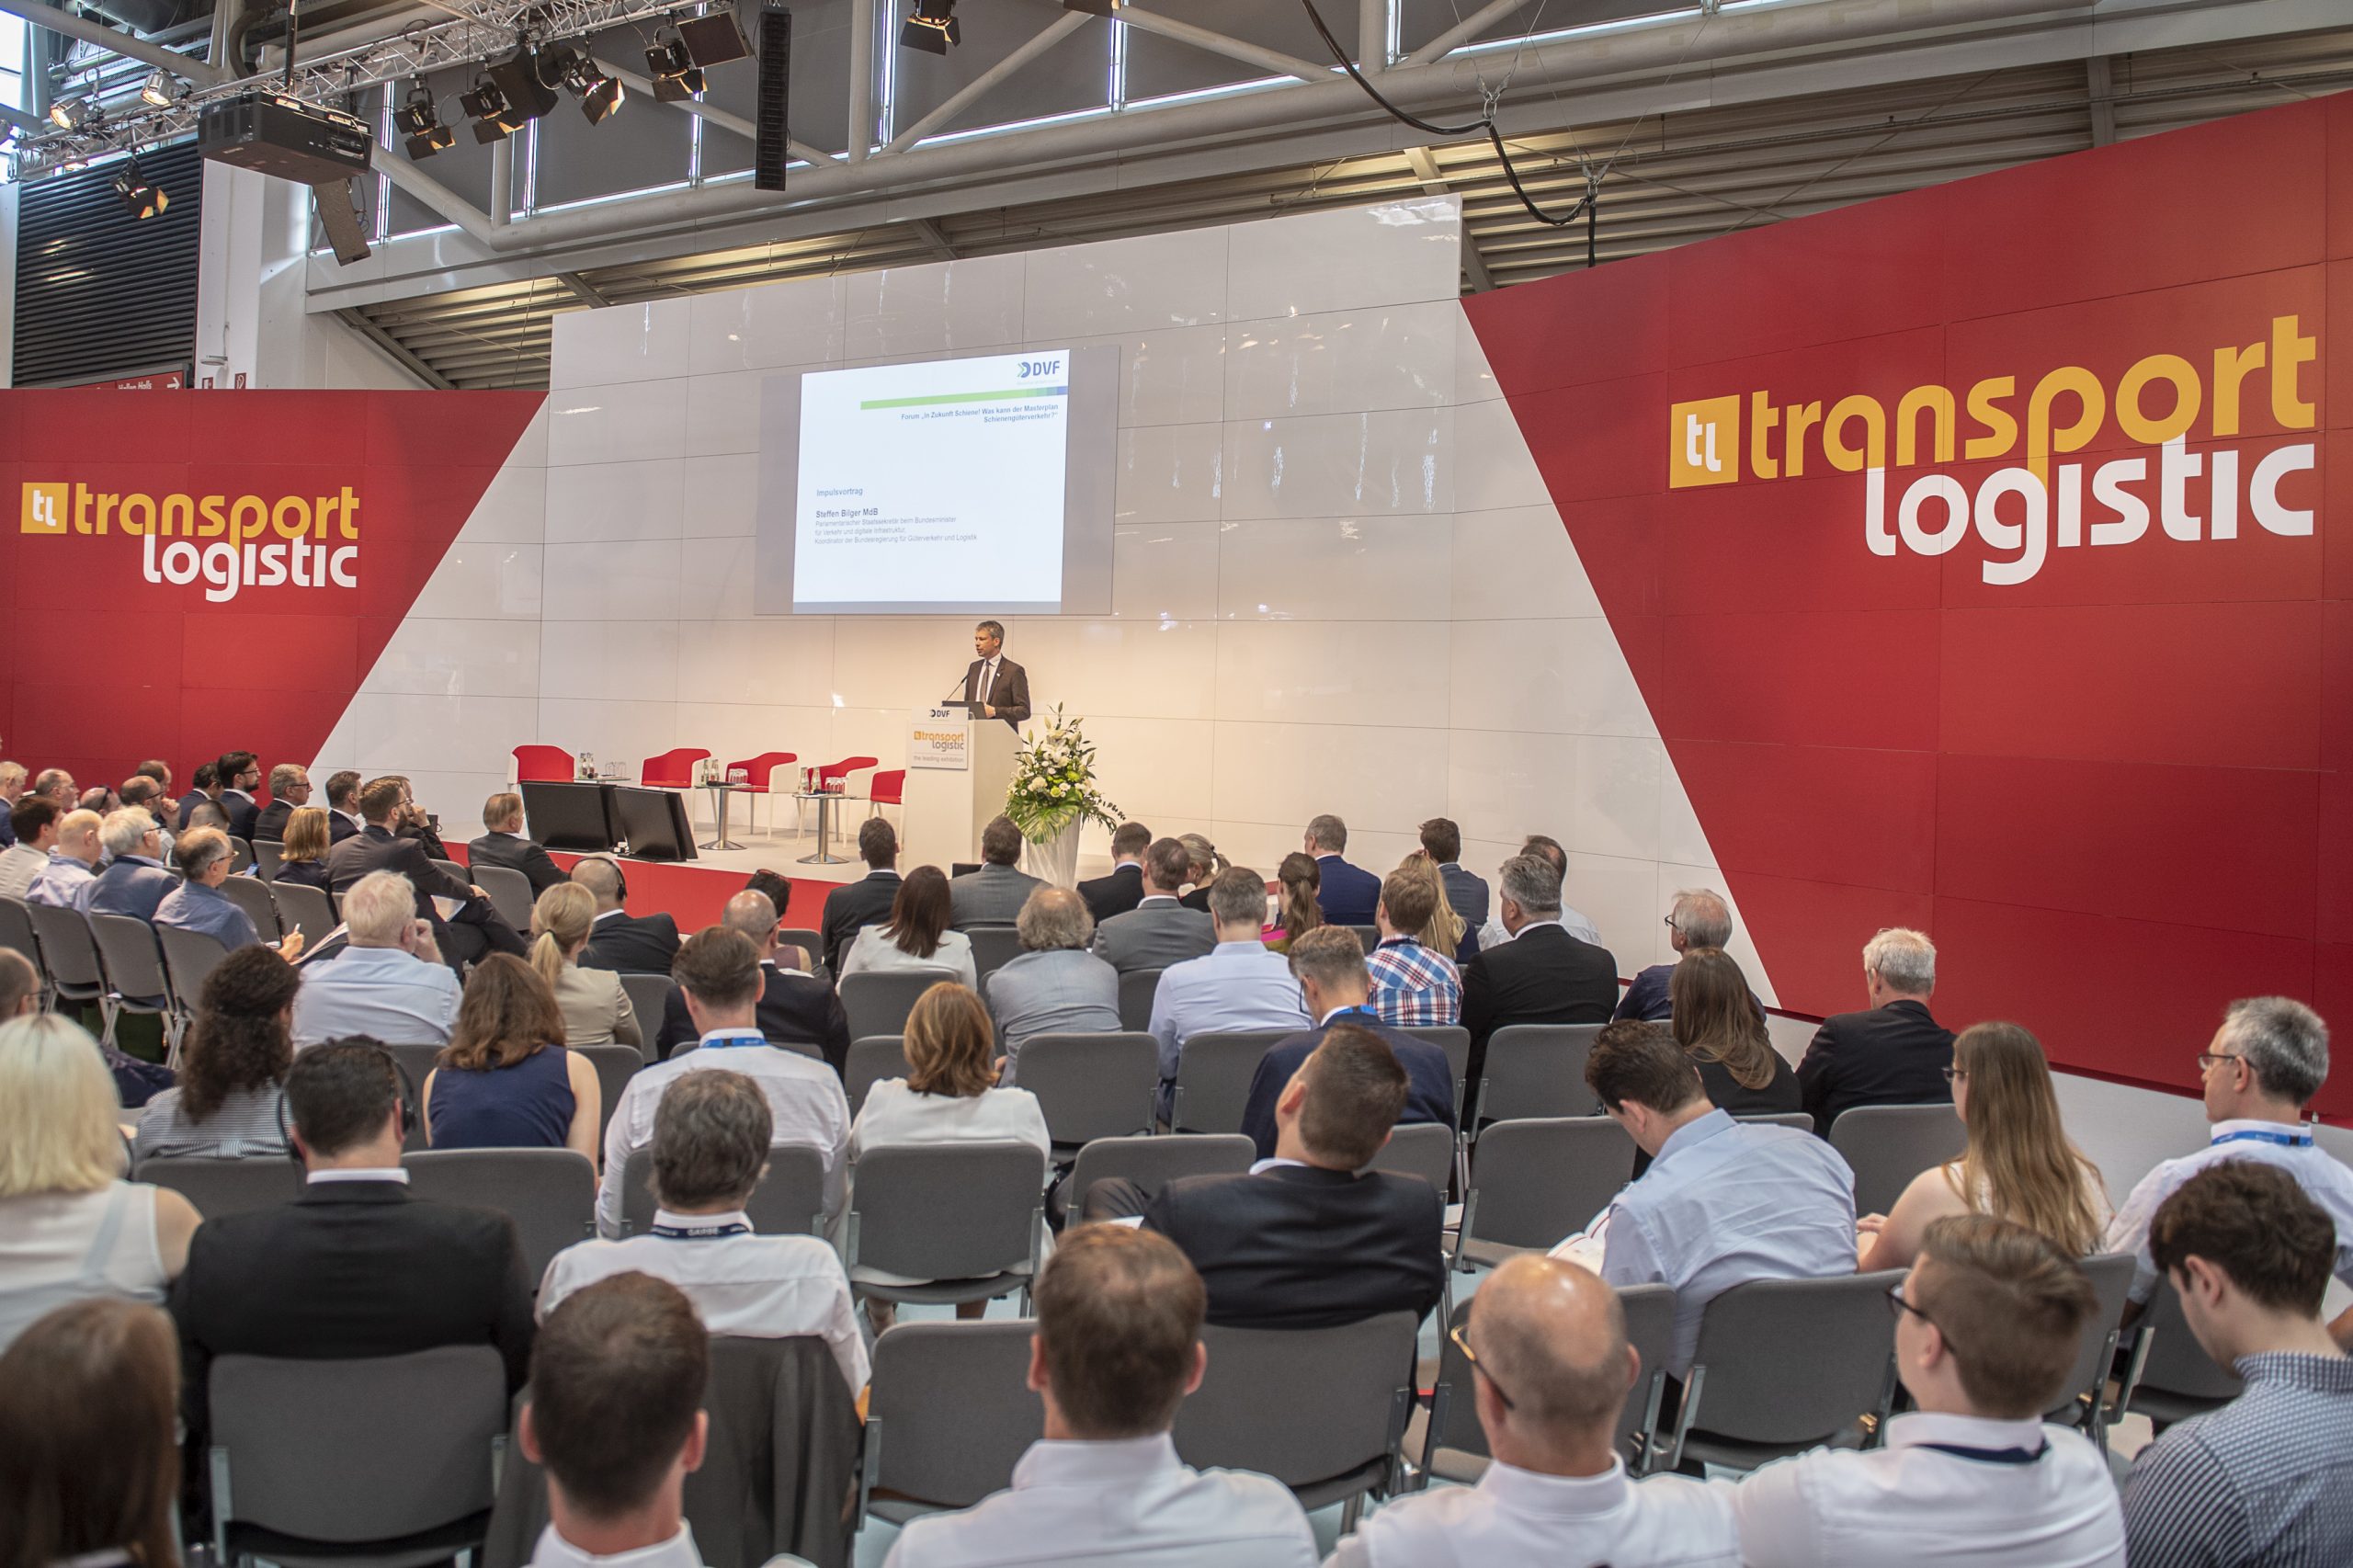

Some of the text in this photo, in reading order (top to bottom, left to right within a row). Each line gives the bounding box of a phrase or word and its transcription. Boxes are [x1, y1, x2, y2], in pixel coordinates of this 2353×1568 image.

[1032, 360, 1060, 376] DVF
[1751, 314, 2316, 491] transport
[931, 411, 953, 419] Zukunft
[1024, 403, 1059, 413] Masterplan
[816, 488, 863, 497] Impulsvortrag
[815, 507, 879, 518] Steffen Bilger MdB
[1865, 432, 2315, 585] logistic
[74, 483, 359, 553] transport
[143, 534, 358, 603] logistic
[937, 710, 950, 718] DVF
[922, 731, 964, 743] transport
[932, 739, 963, 752] logistic
